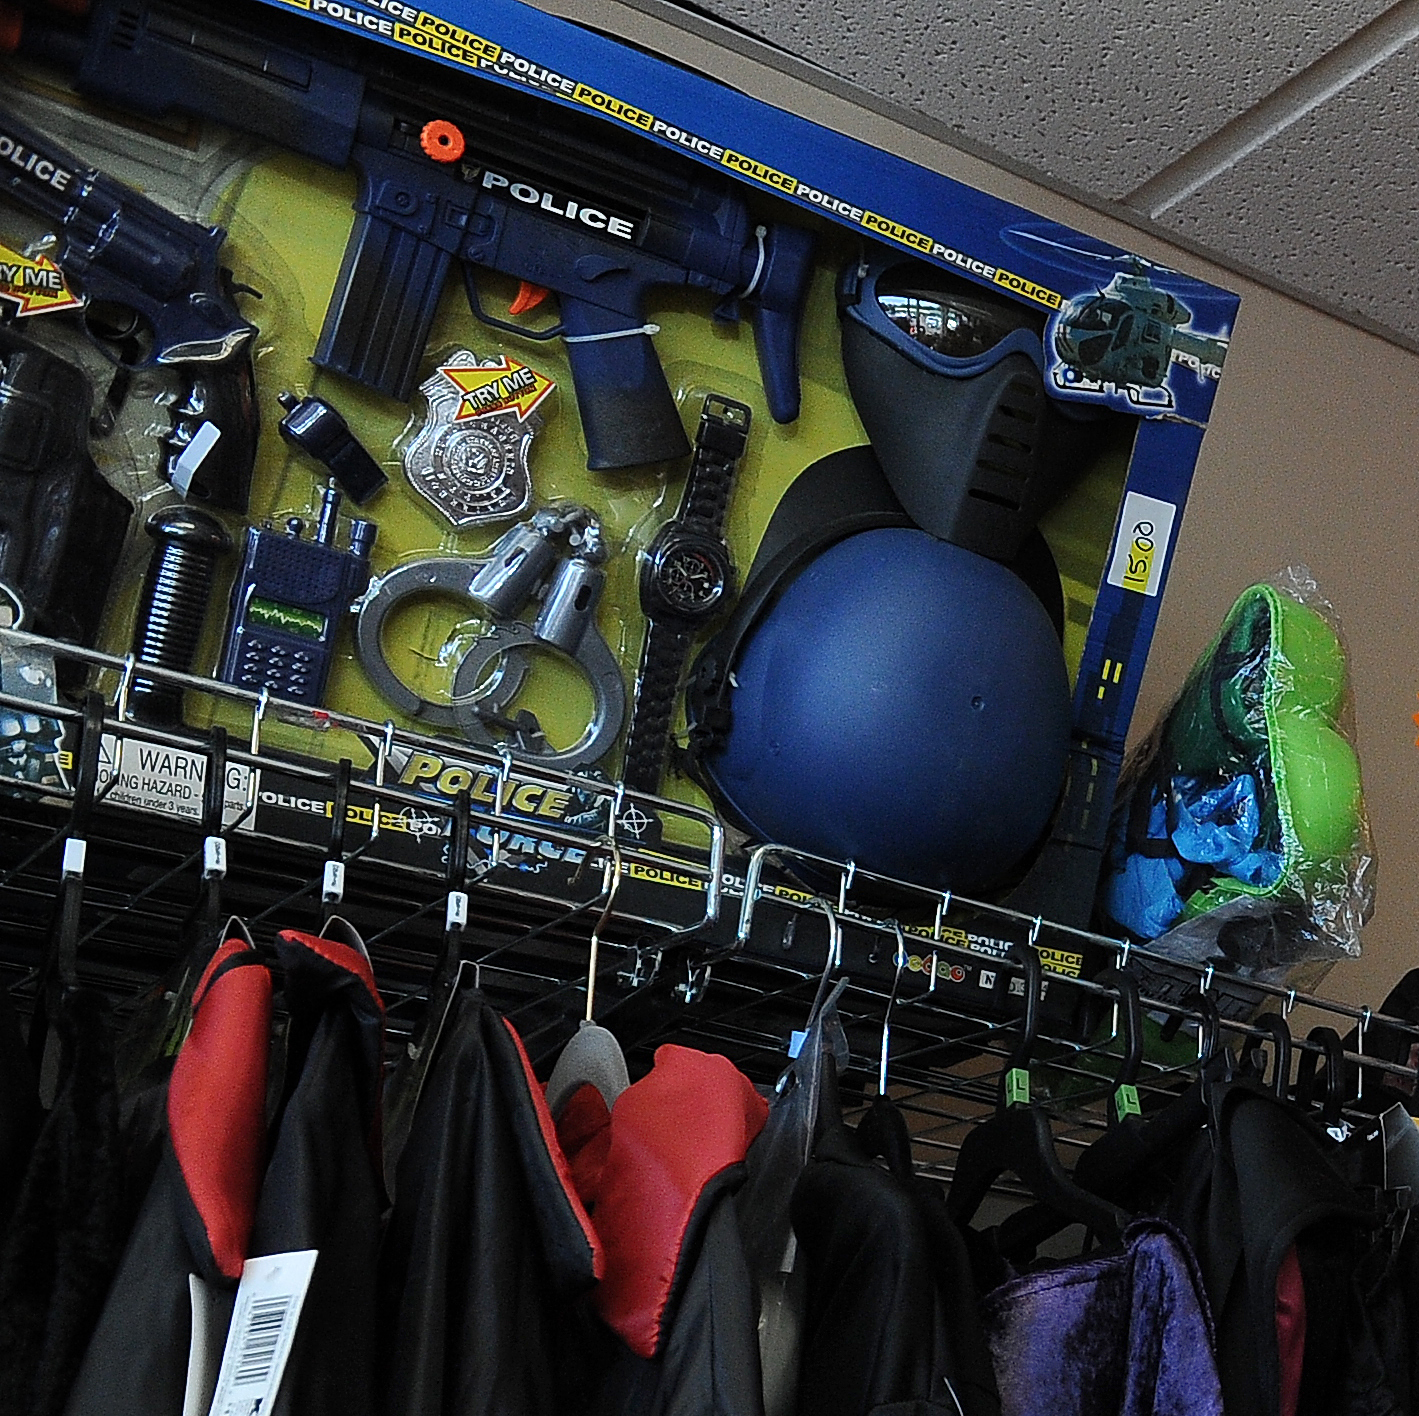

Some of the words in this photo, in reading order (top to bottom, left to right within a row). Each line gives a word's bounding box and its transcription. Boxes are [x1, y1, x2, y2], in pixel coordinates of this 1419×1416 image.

[313, 0, 394, 36] POLICE
[397, 26, 476, 64] POLICE
[0, 136, 71, 192] OLICE
[419, 18, 497, 58] POLICE
[500, 51, 576, 94] POLICE
[578, 86, 652, 127] POLICE
[653, 120, 723, 160] POLICE
[725, 153, 795, 191] POLICE
[796, 184, 863, 222] POLICE
[865, 214, 931, 250] POLICE
[933, 243, 996, 279] POLICE
[997, 272, 1059, 307] POLICE
[482, 171, 634, 240] POLICE
[24, 267, 62, 290] ME
[463, 381, 500, 409] TRY
[501, 367, 535, 392] ME
[1123, 521, 1154, 583] 15.00
[139, 748, 248, 791] WARNG:
[141, 777, 192, 800] HAZARD
[400, 750, 574, 818] POLICE
[259, 791, 325, 814] OLICE
[634, 865, 702, 889] POLICE
[1040, 949, 1083, 966] OLICE
